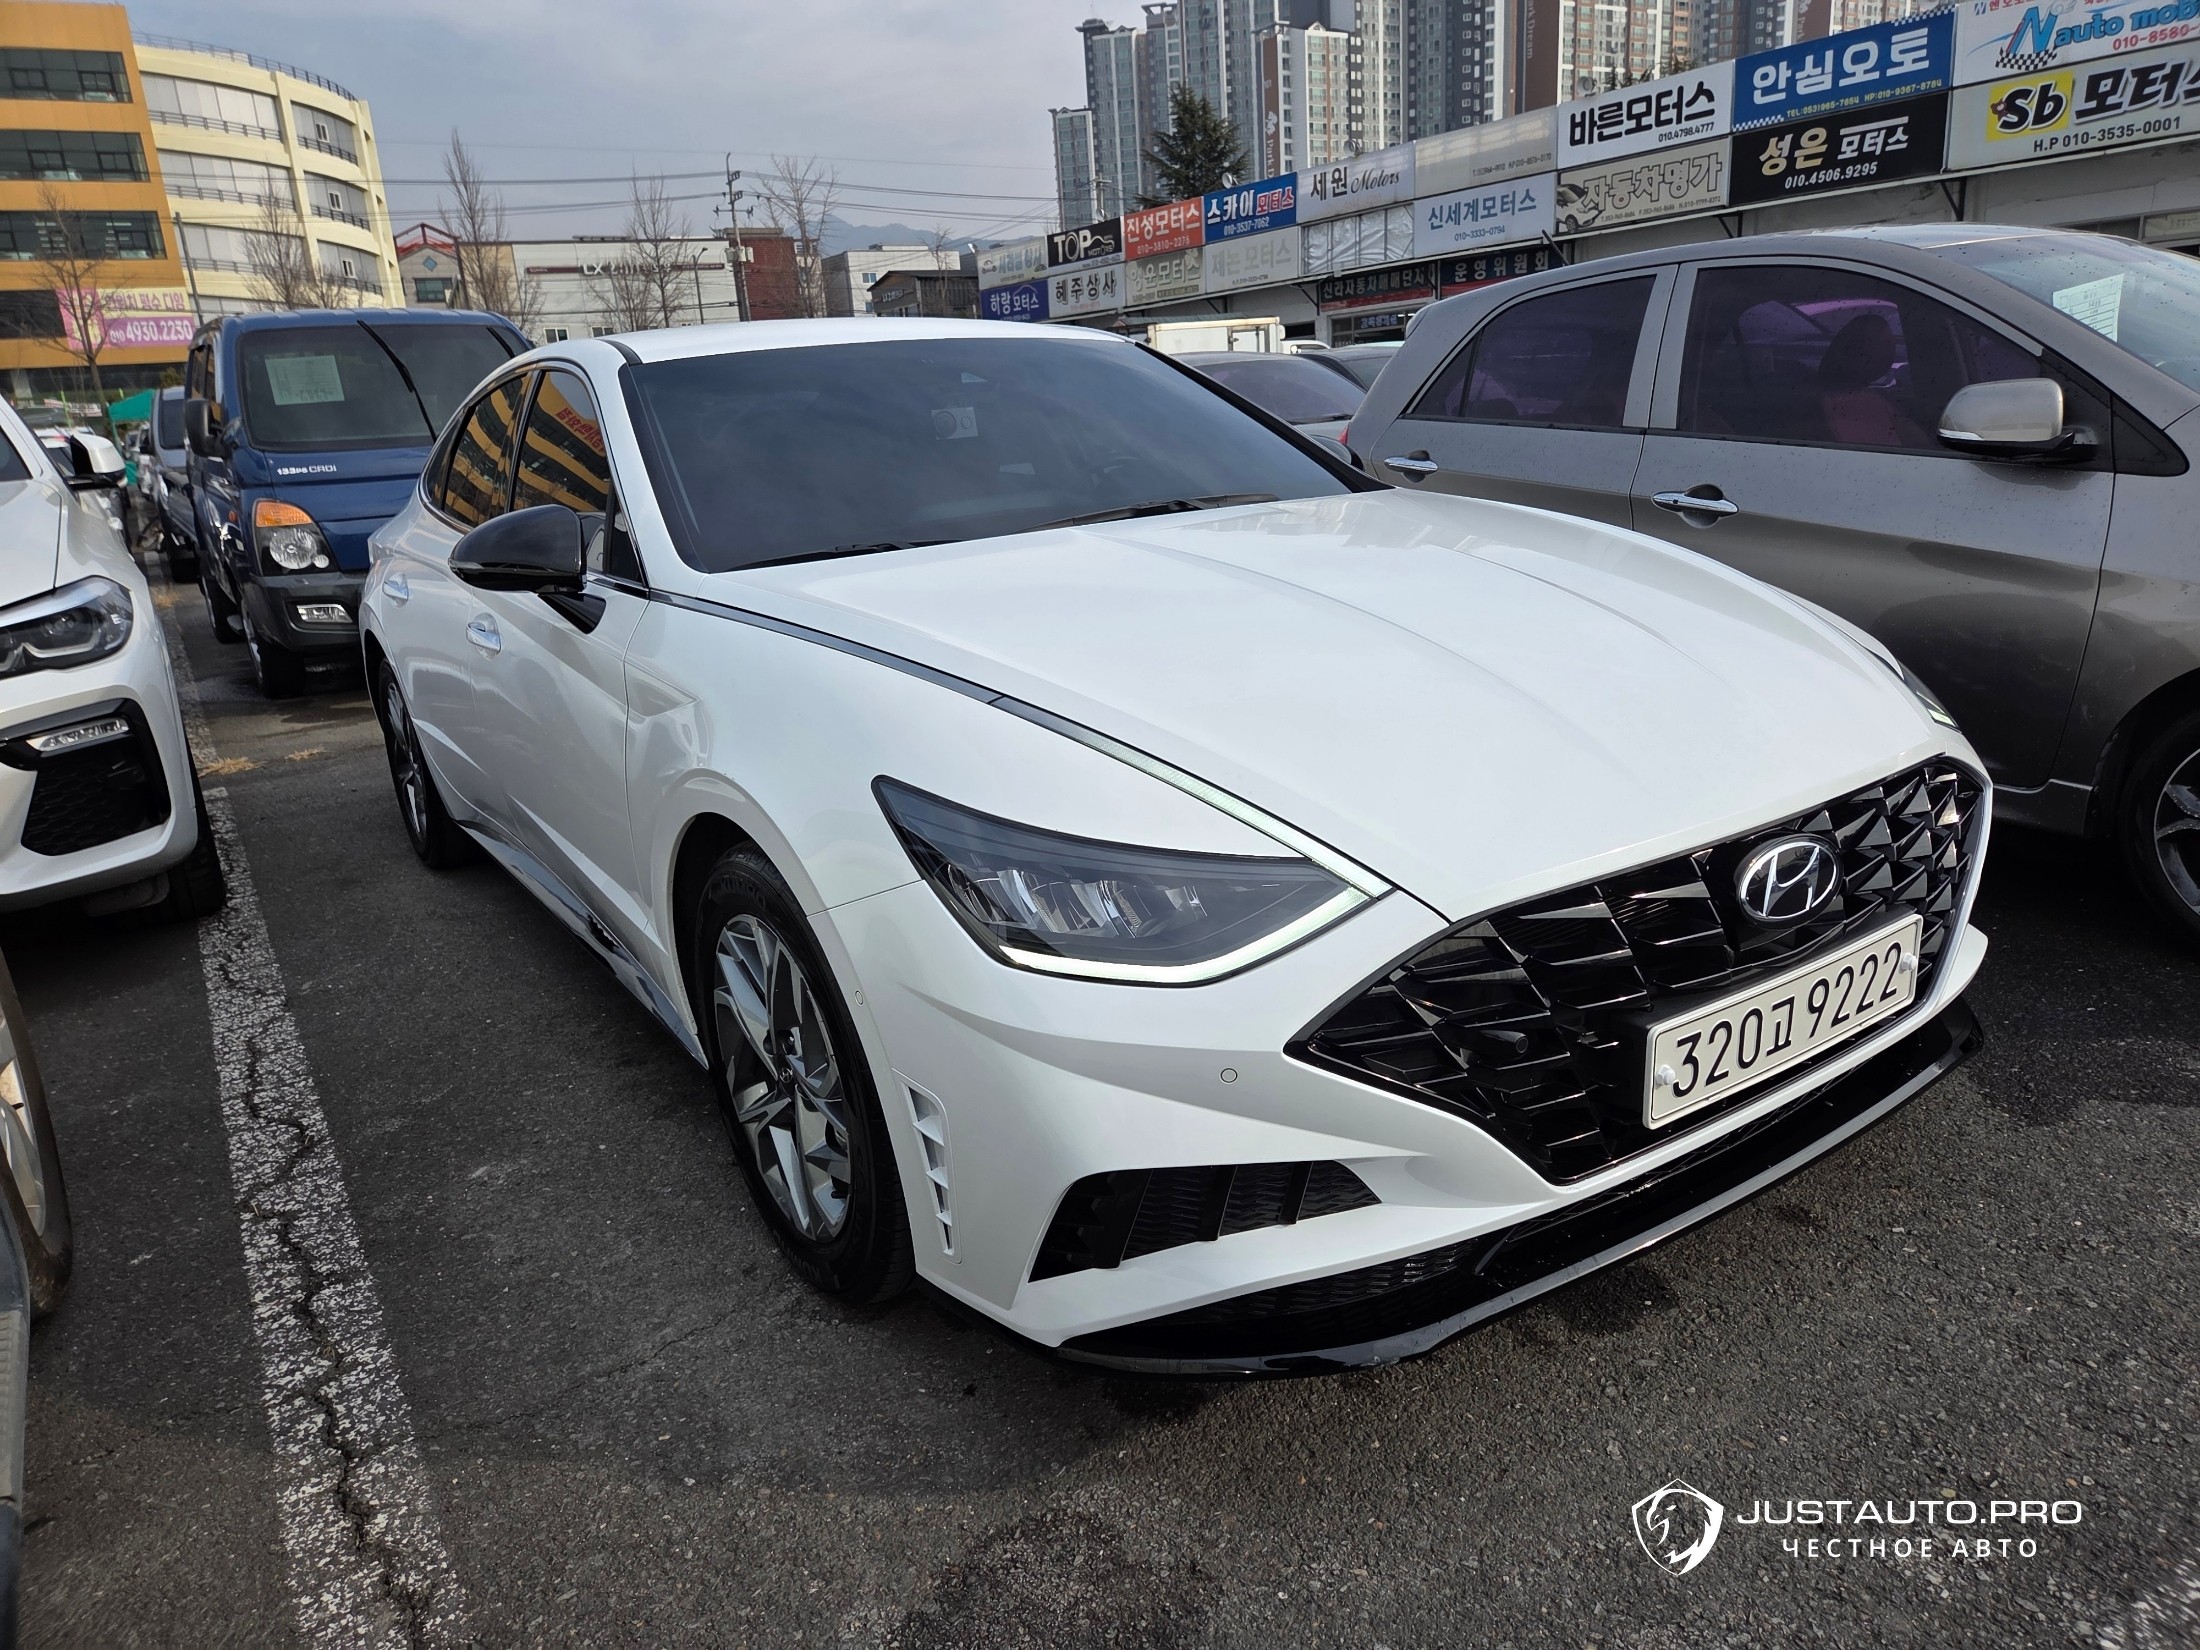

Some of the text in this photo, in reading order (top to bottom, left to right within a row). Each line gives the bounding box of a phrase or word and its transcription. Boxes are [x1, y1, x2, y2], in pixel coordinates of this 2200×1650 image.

[2129, 0, 2200, 32] mob
[1527, 19, 1536, 60] Dream
[2112, 23, 2200, 51] 010-8580-
[1752, 27, 1930, 105] 안심오토
[1569, 80, 1716, 147] 바른모터스
[1999, 82, 2067, 131] Sb
[1658, 121, 1715, 143] 010.4798.4777
[2062, 116, 2182, 147] 010-3535-0001
[1266, 139, 1275, 166] Park
[1758, 126, 1910, 176] 성은 모터스
[1310, 165, 1400, 201] 세원 Motors
[1581, 152, 1723, 211] 자동차명가
[1784, 161, 1878, 190] 010.4506.9295
[1126, 203, 1200, 243] 진성모터스
[1207, 189, 1255, 225] 스카이
[1427, 188, 1537, 231] 신세계모터스
[1053, 229, 1092, 263] TOP
[1088, 244, 1114, 257] MOTORS
[583, 262, 604, 276] LX
[1454, 250, 1549, 283] 운영위원회
[989, 291, 1040, 315] 하랑 모터스
[109, 330, 126, 343] 010
